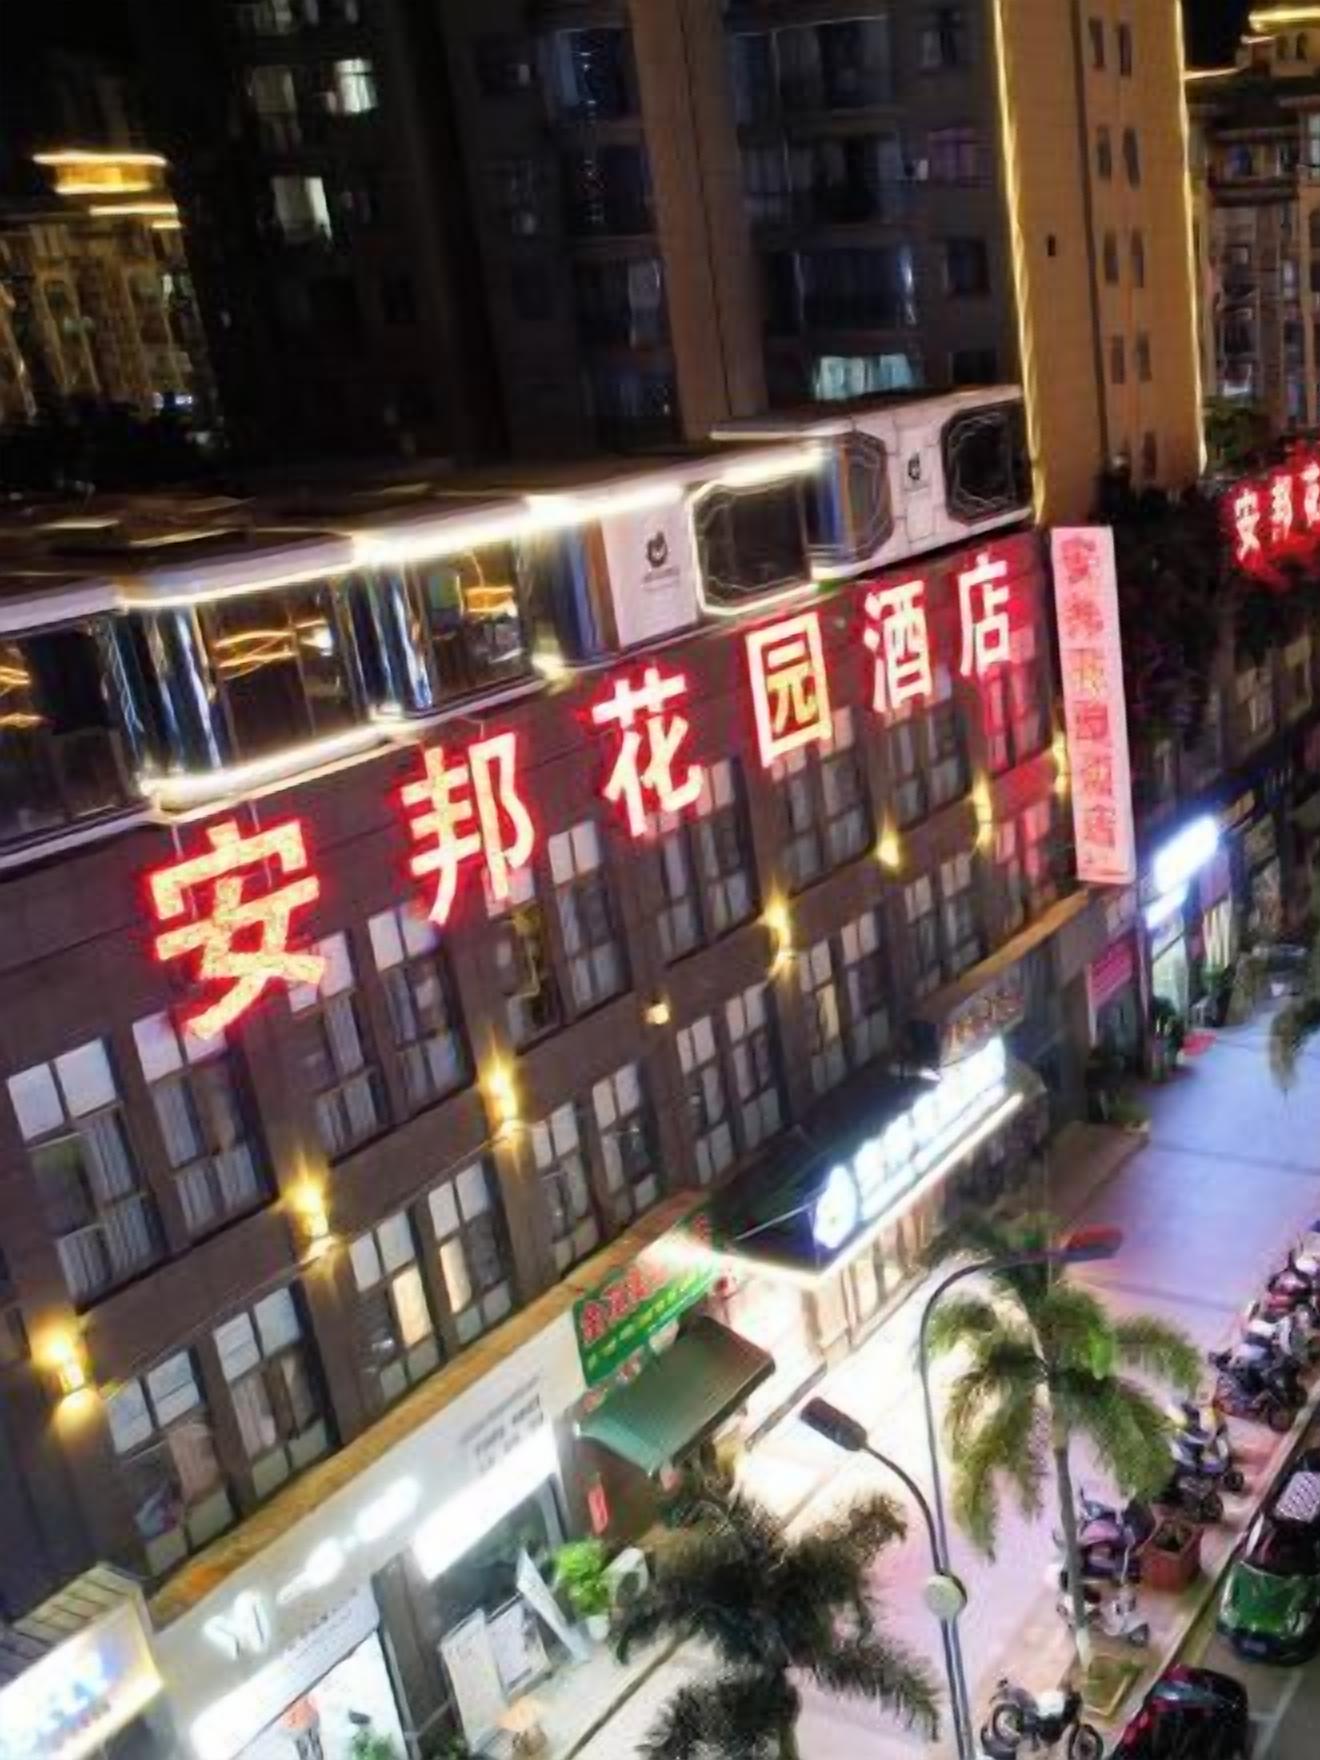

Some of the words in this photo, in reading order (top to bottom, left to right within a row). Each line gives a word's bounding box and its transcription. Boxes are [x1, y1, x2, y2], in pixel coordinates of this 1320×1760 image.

[150, 553, 1012, 1039] 安邦花园酒店
